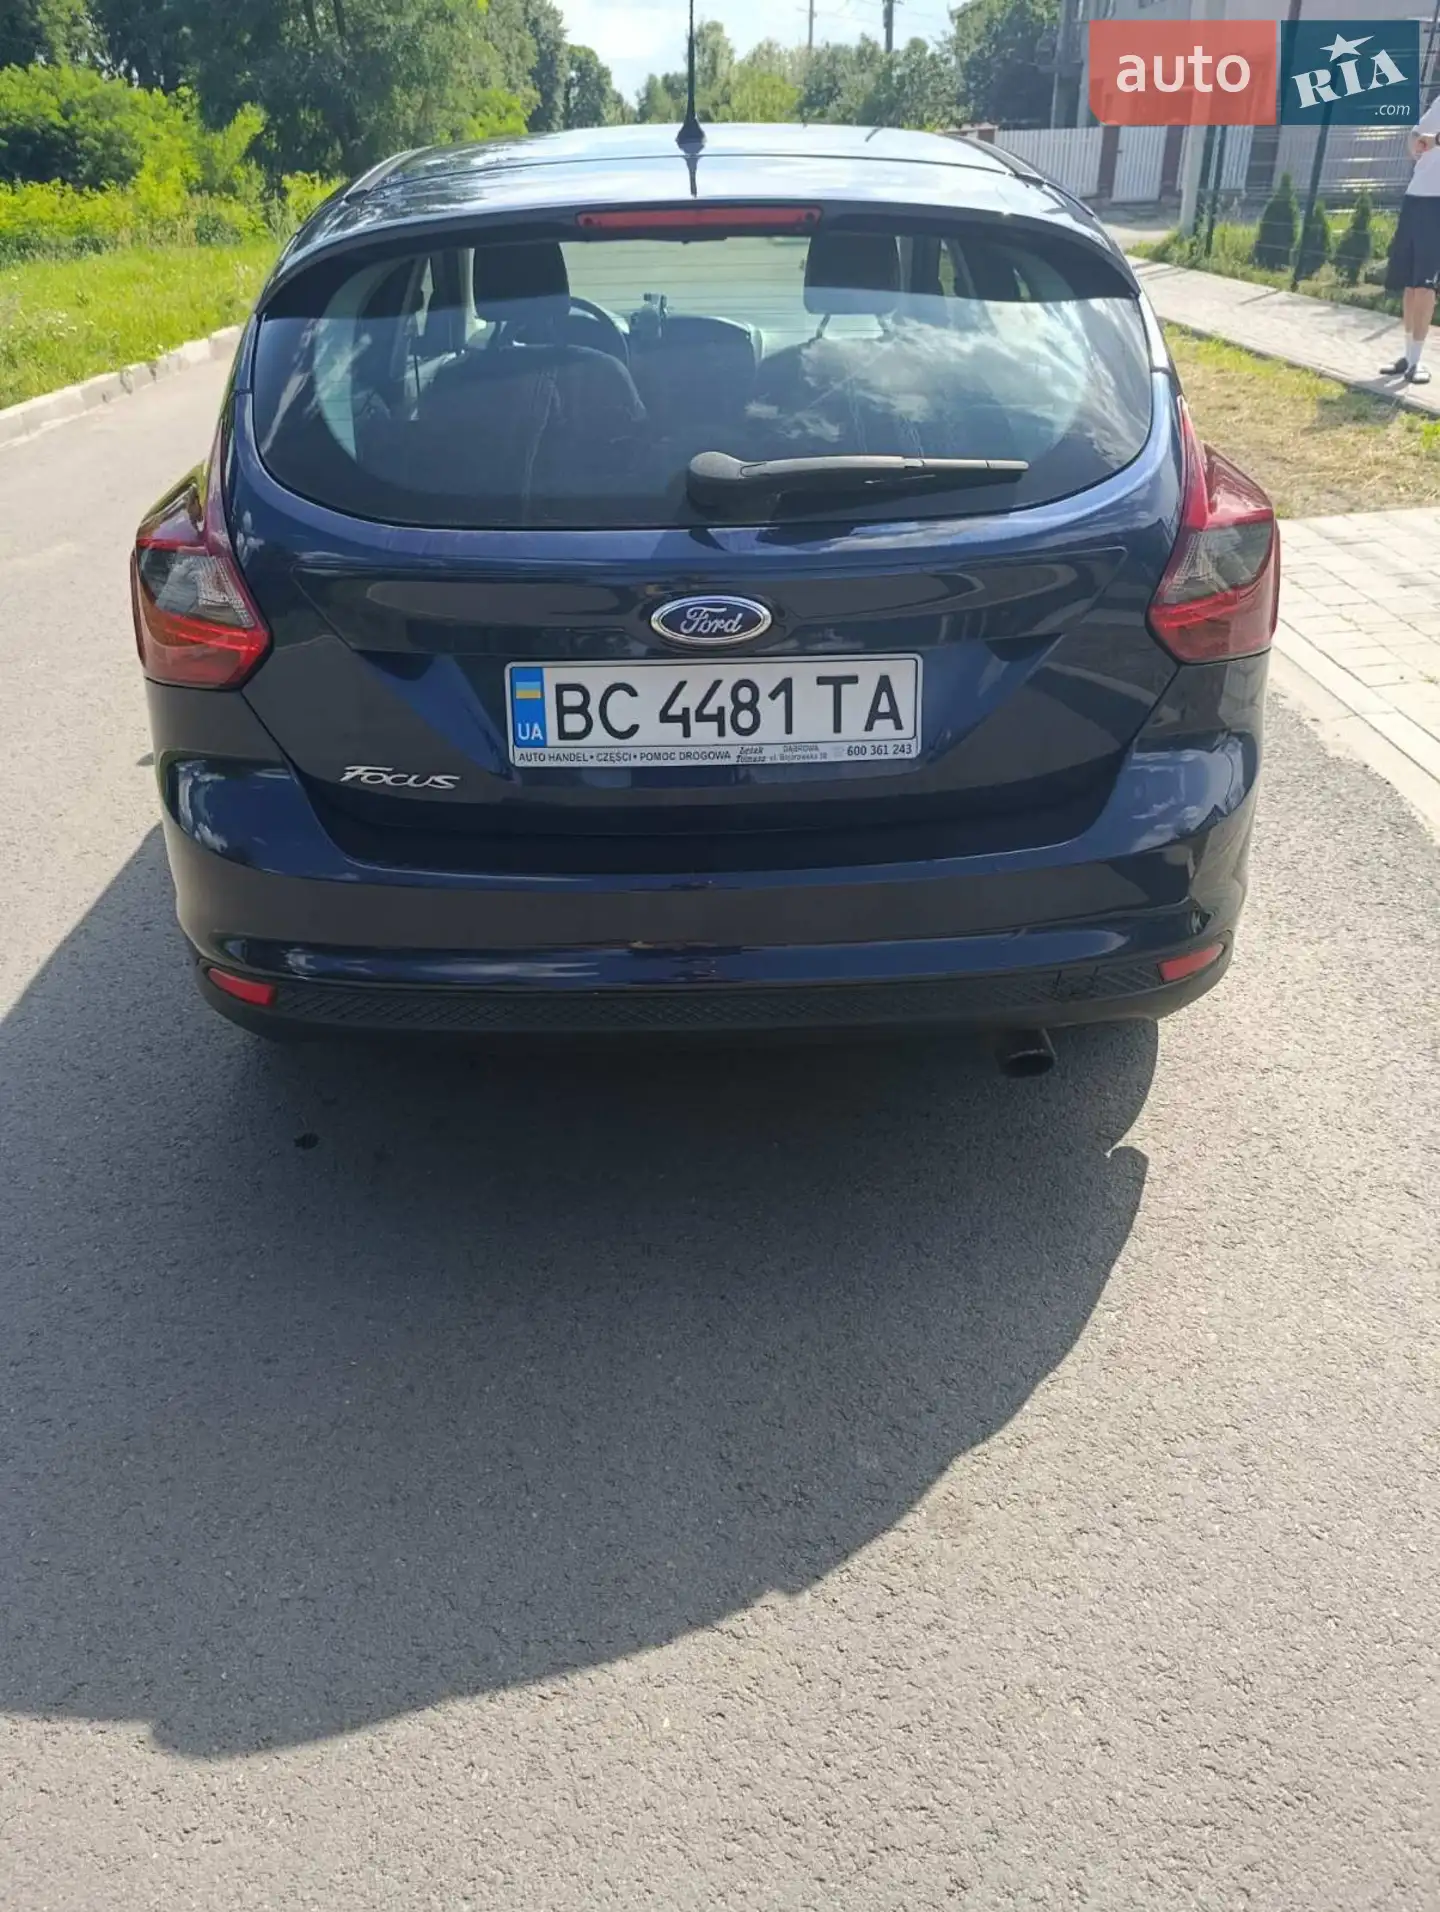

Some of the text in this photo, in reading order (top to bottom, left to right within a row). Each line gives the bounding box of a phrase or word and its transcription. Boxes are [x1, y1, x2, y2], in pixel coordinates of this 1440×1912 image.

[680, 606, 743, 634] Ford
[555, 674, 904, 741] BC 4481 TA
[518, 723, 544, 741] UA
[519, 751, 546, 762] AUTO
[548, 751, 589, 762] HANDEL
[639, 751, 676, 762] POMOC
[679, 750, 732, 761] DROGOWA
[847, 743, 912, 756] 600 361 243
